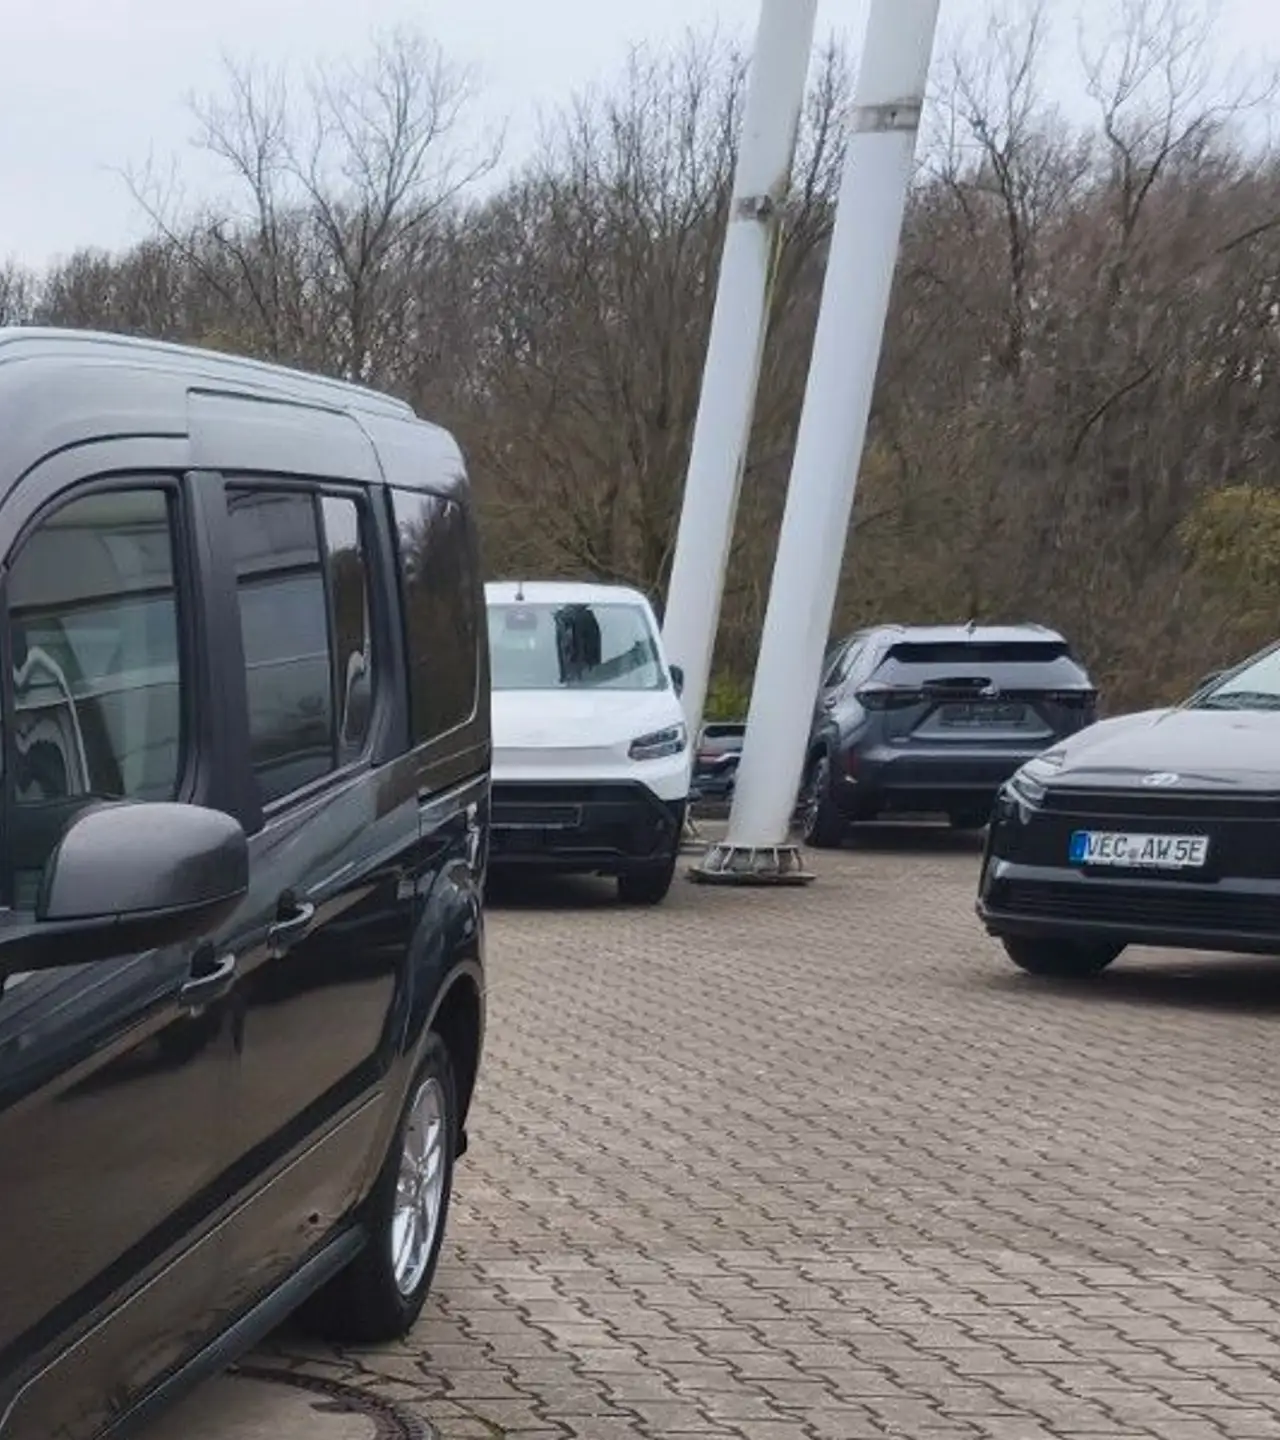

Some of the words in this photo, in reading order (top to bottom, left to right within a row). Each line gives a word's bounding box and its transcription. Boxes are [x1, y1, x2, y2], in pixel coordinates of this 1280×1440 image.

[1088, 835, 1128, 858] VEC
[1140, 837, 1172, 860] AW
[1175, 839, 1205, 862] 5E
